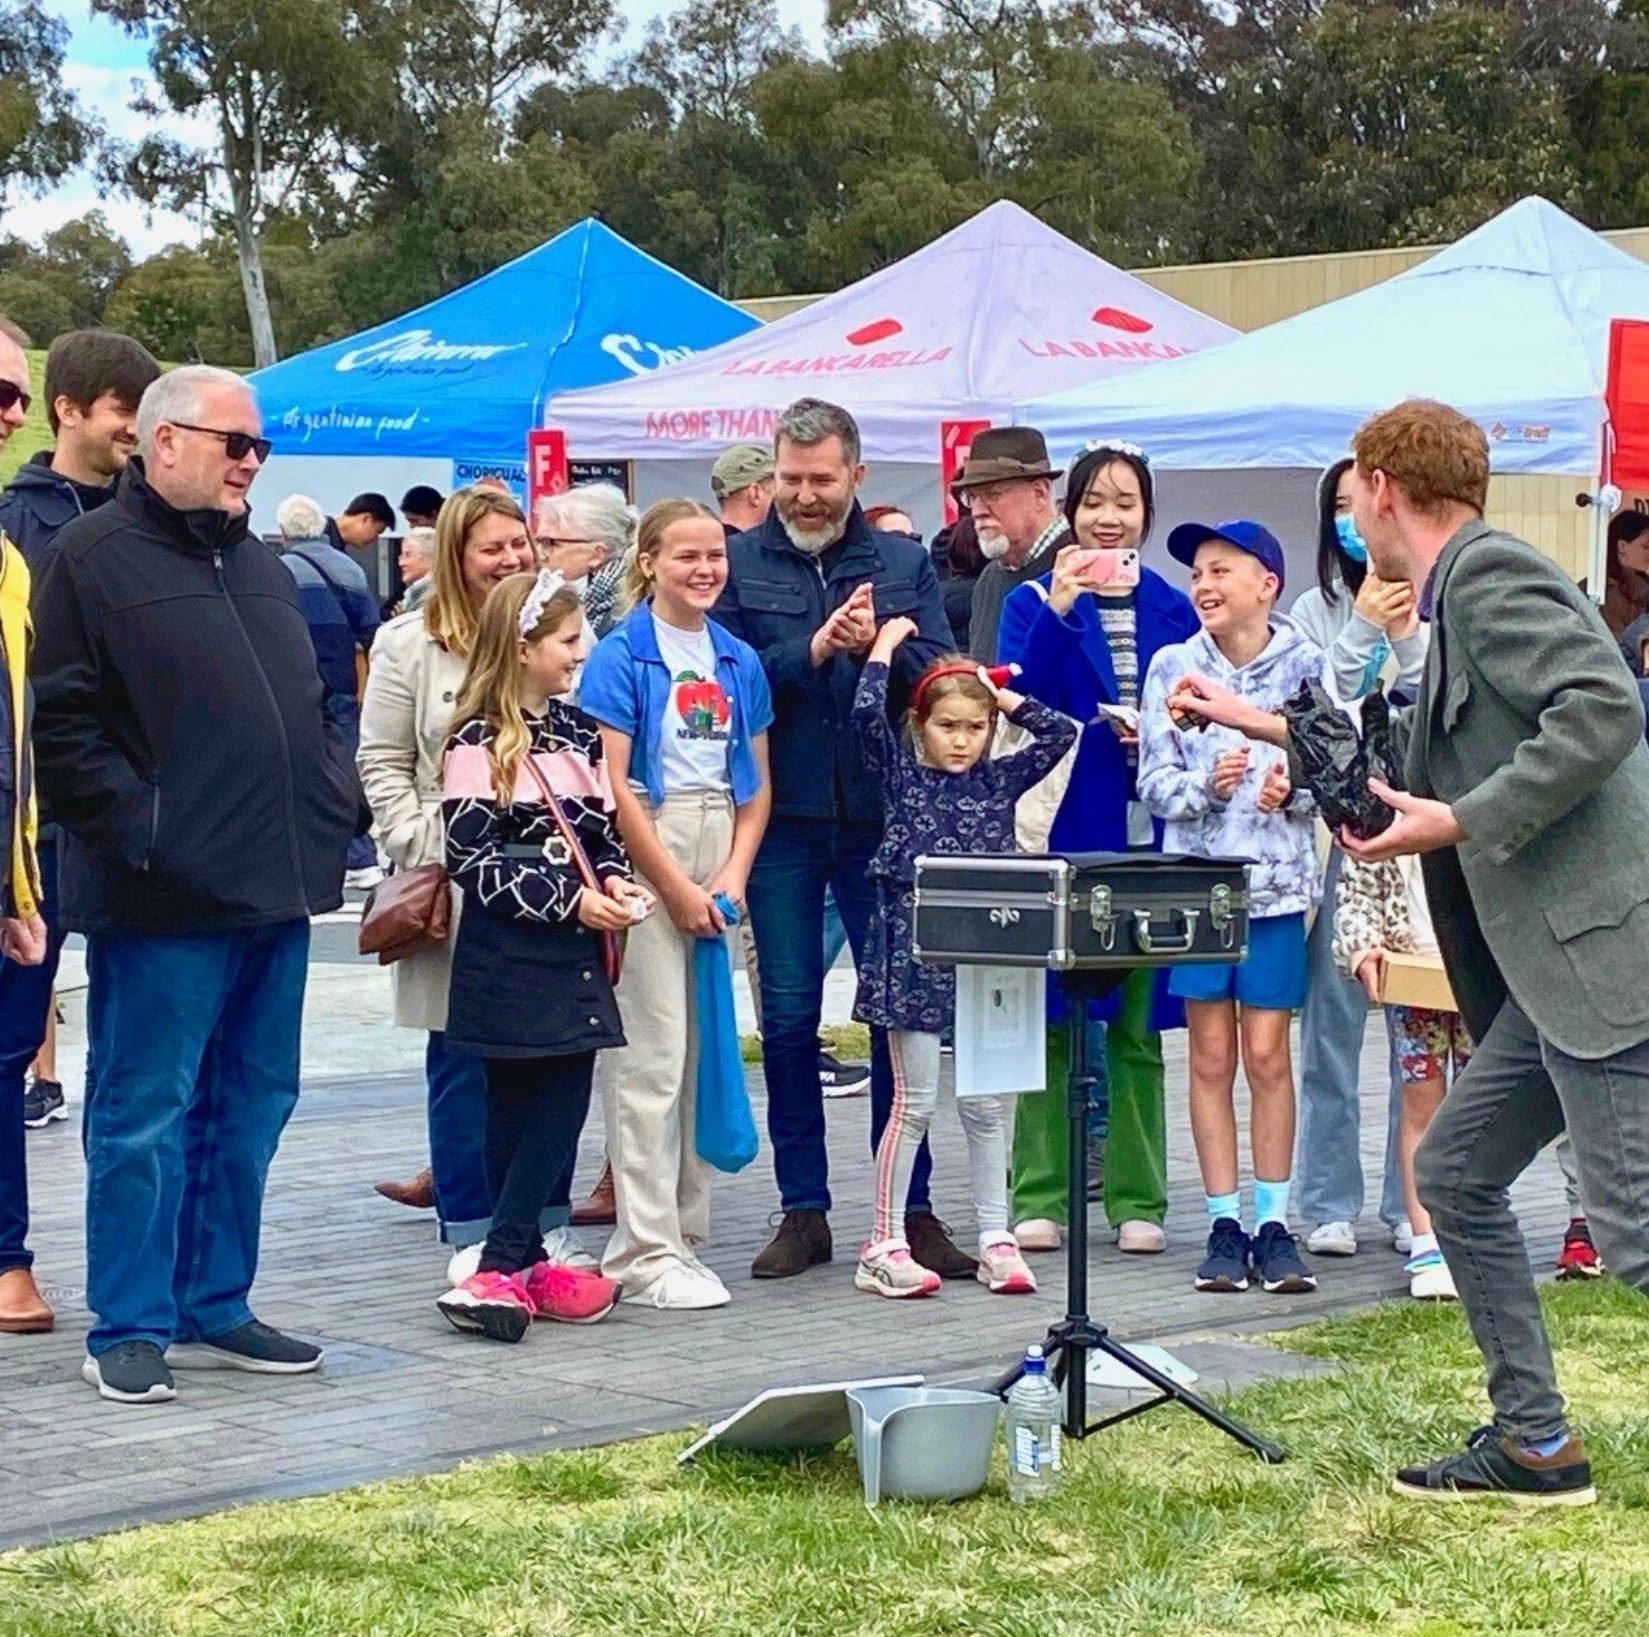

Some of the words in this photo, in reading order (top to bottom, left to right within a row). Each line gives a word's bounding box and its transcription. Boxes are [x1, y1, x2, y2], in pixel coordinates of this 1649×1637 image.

[722, 361, 766, 375] LA
[763, 347, 952, 375] BANCARELLA
[1018, 339, 1077, 357] LA
[646, 410, 711, 438] MORE
[716, 409, 784, 437] THAN
[534, 445, 552, 487] F
